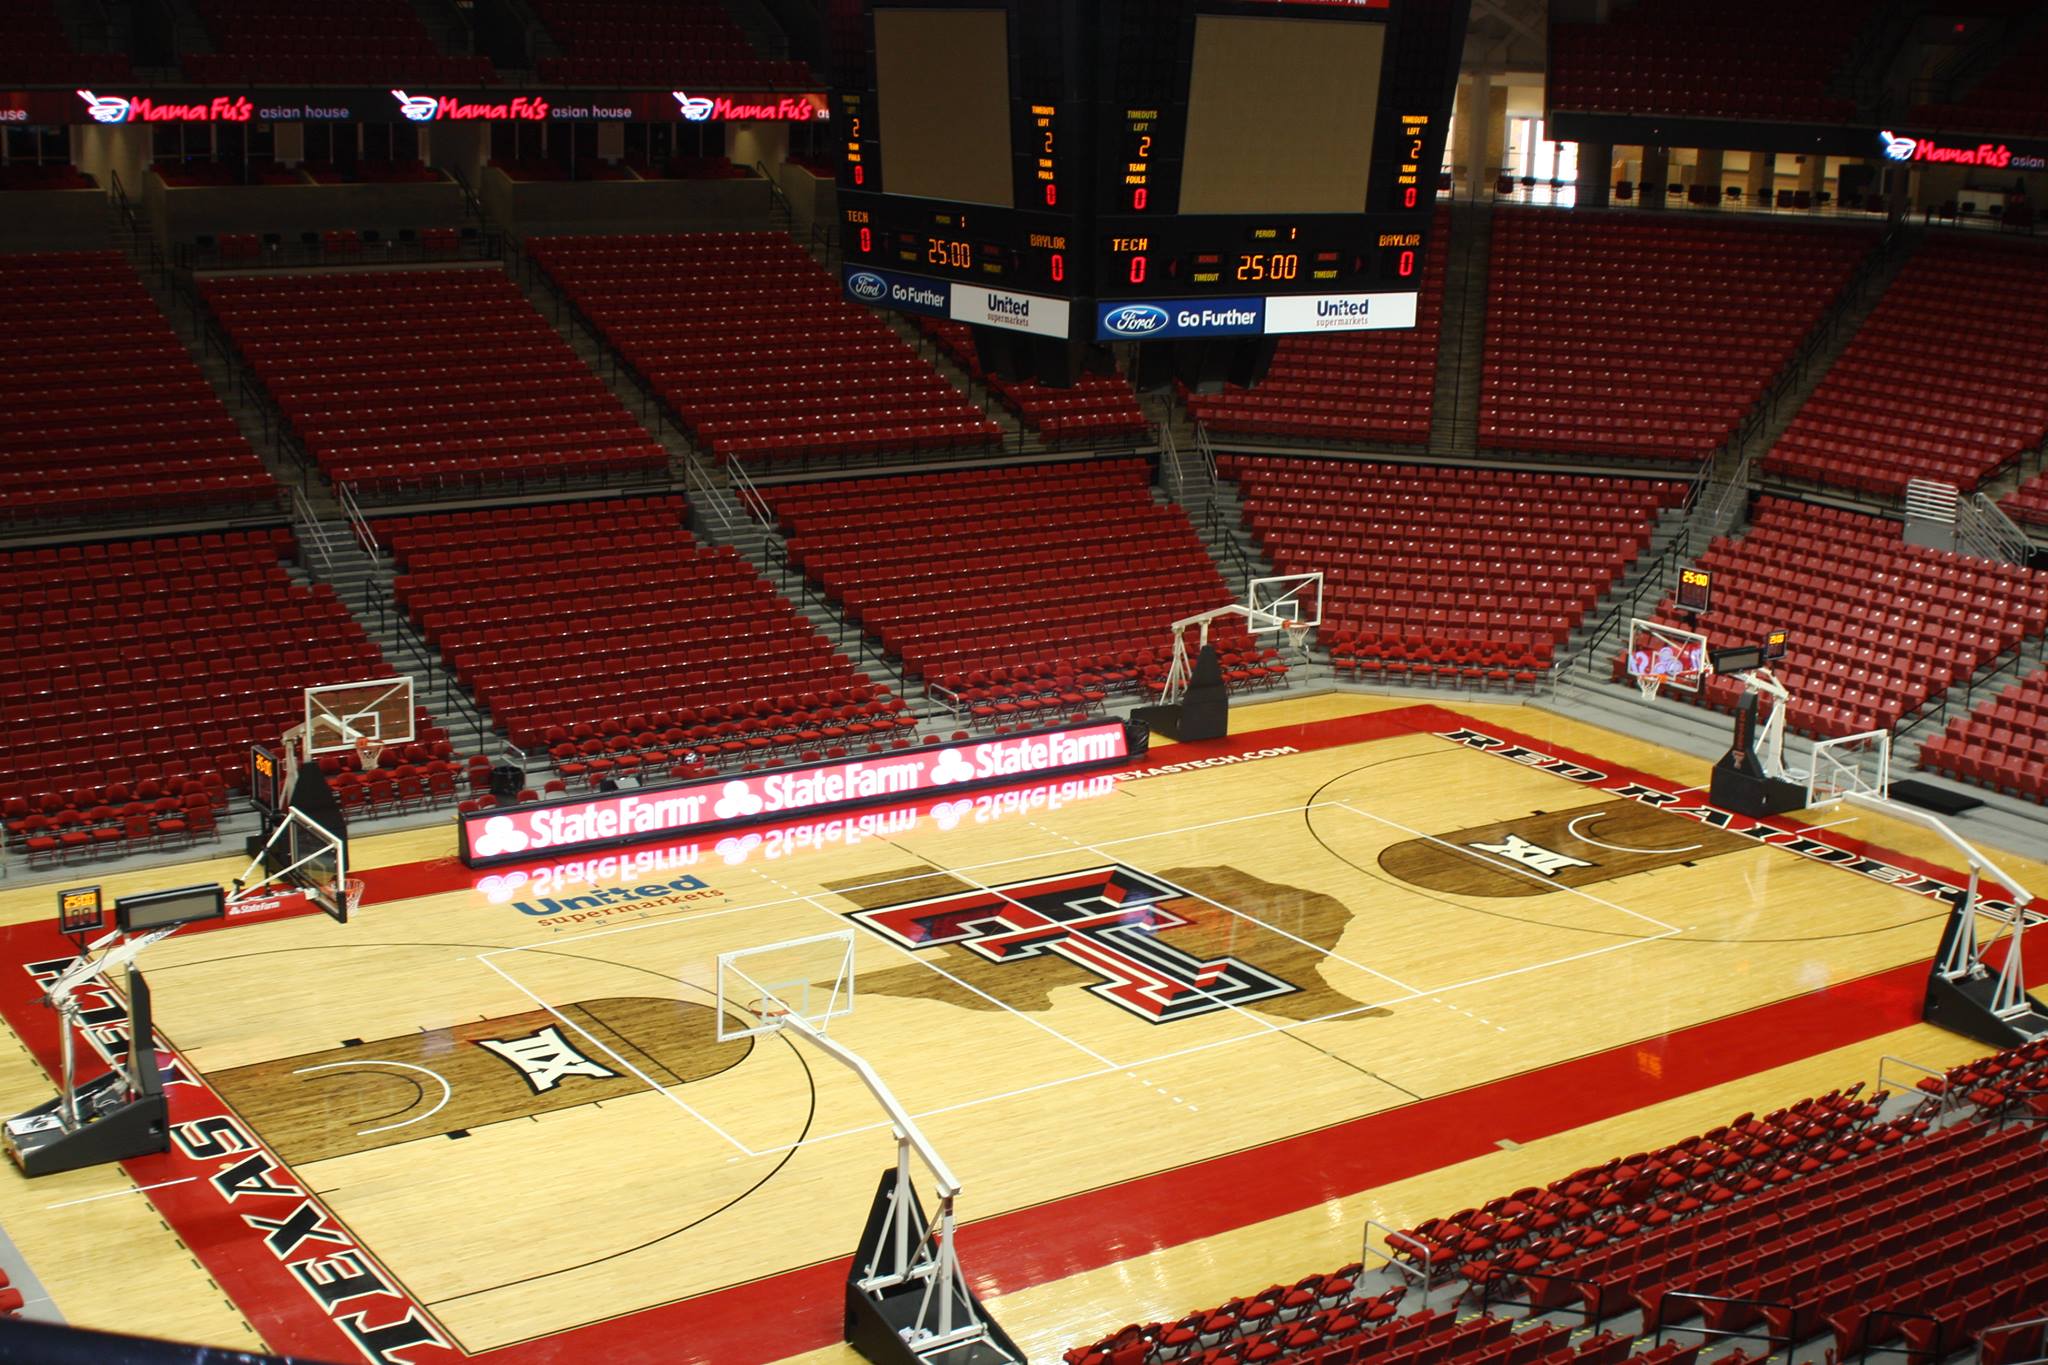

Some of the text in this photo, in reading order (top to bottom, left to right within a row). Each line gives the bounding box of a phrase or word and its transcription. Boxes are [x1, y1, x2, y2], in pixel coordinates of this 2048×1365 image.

[128, 96, 350, 121] Mama Fu's asian house
[435, 96, 633, 120] Mama Fu's asian house
[711, 97, 775, 120] Mama
[778, 98, 813, 121] Fu's
[853, 118, 860, 138] 2
[1045, 132, 1054, 153] 2
[1138, 136, 1150, 157] 2
[1410, 140, 1422, 159] 2
[1915, 139, 2046, 169] Mama Fu's asian
[854, 165, 864, 186] 0
[1129, 163, 1146, 172] TEAM
[1126, 175, 1146, 184] FOULS
[1046, 184, 1057, 206] 0
[1133, 187, 1147, 210] 0
[1404, 187, 1417, 208] 0
[848, 209, 869, 223] TECH
[860, 227, 872, 252] 0
[1030, 233, 1066, 250] BAYLOR
[1113, 238, 1148, 252] TECH
[1290, 228, 1297, 240] 1
[1379, 234, 1421, 247] BAYLOR
[928, 238, 971, 269] 25:00
[1399, 251, 1415, 277] 0
[1051, 254, 1064, 282] 0
[1130, 256, 1147, 284] 0
[1237, 254, 1298, 281] 25:00
[855, 275, 880, 296] Ford
[892, 284, 945, 308] Go Further
[988, 293, 1030, 317] United
[1317, 299, 1369, 317] United
[1115, 307, 1158, 331] Ford
[1177, 308, 1257, 328] Go Further
[1315, 315, 1369, 327] supermarkets
[1682, 570, 1709, 587] 25:00
[1112, 746, 1300, 781] EXASTECH.COM
[1433, 727, 2048, 927] RED RAIDERS
[512, 874, 710, 917] United
[537, 888, 724, 927] supermarkets
